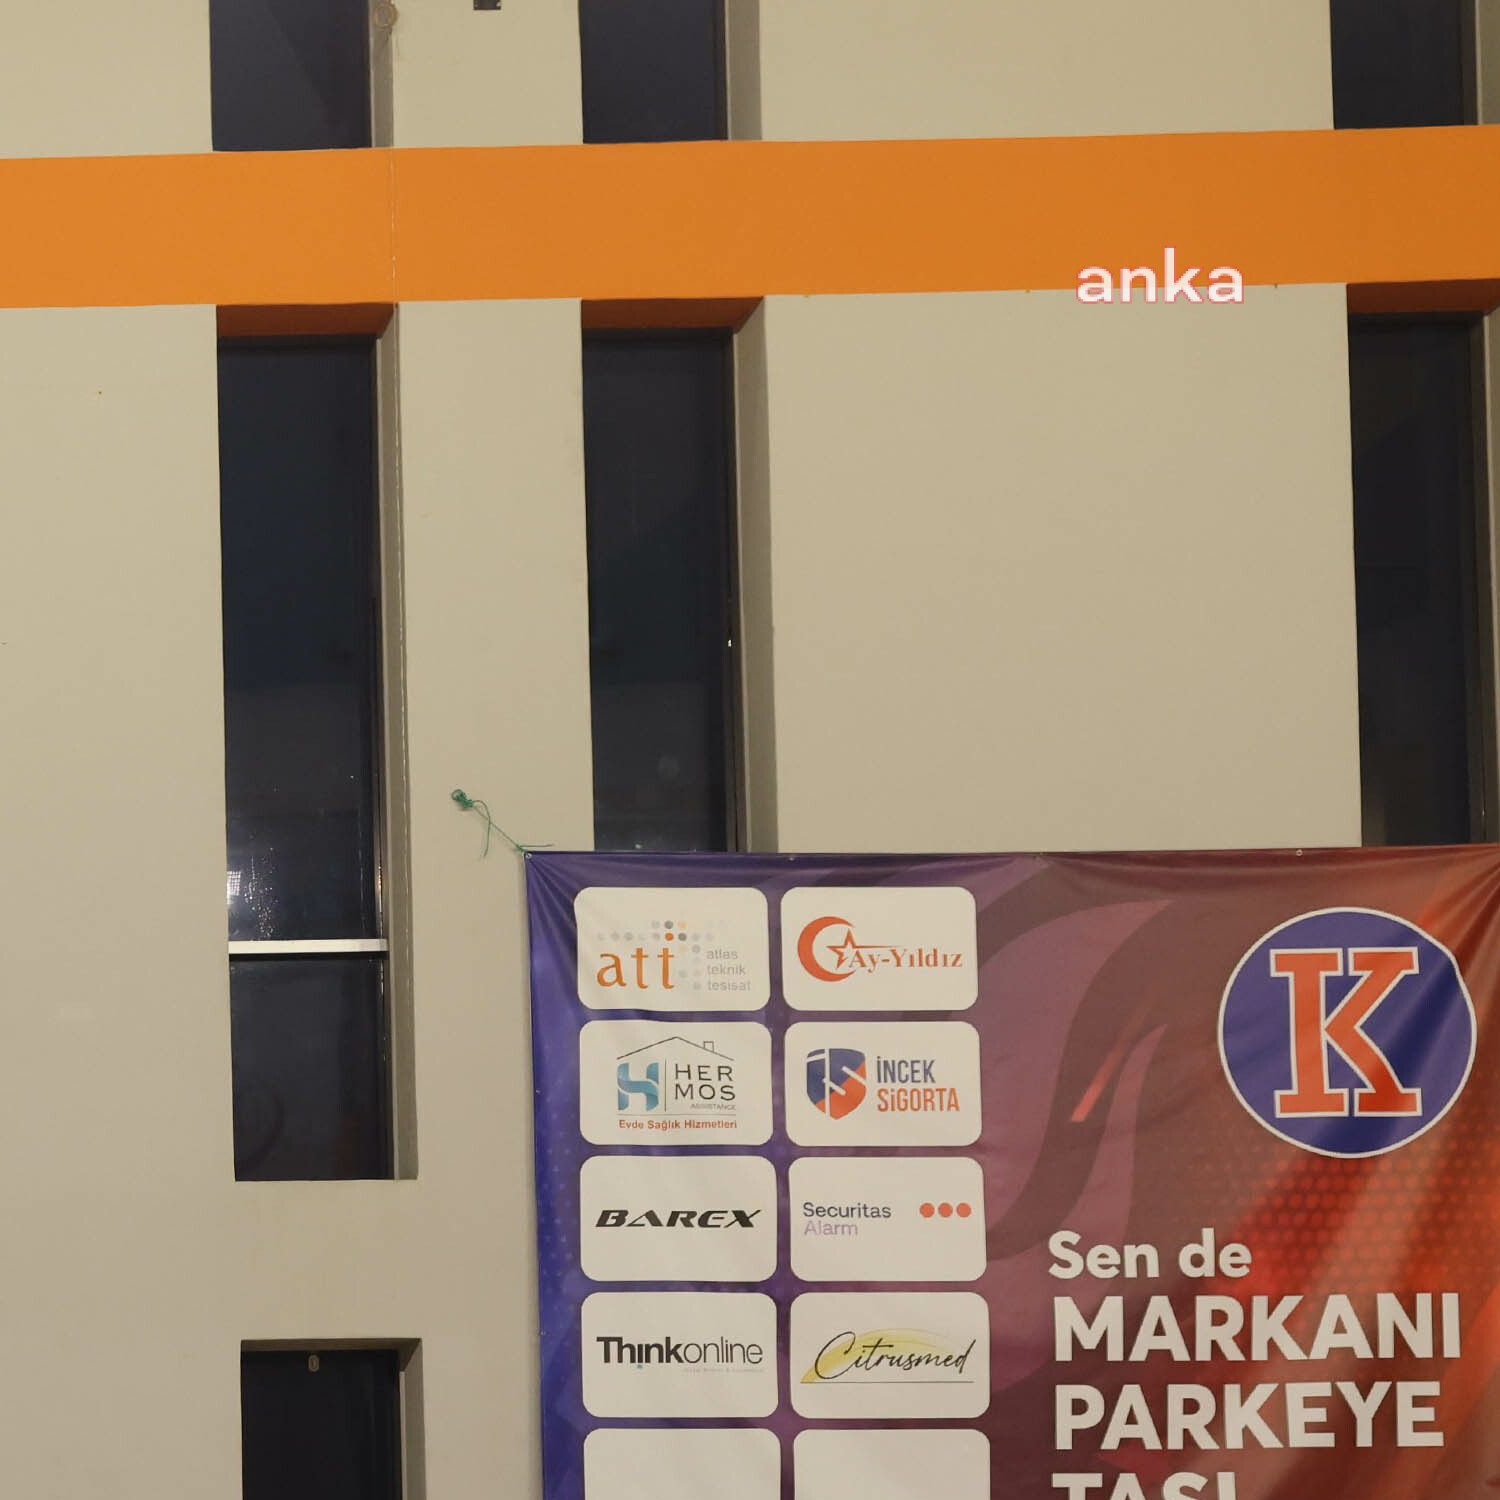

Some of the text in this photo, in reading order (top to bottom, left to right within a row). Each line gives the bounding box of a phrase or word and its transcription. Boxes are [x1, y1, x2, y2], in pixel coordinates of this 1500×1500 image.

[706, 949, 738, 960] atlas
[597, 947, 675, 989] att
[706, 964, 747, 976] teknik
[707, 980, 752, 991] tesisat
[1270, 947, 1422, 1117] K
[674, 1063, 733, 1081] HER
[876, 1056, 935, 1084] İNCEK
[674, 1083, 736, 1101] MOS
[618, 1119, 738, 1132] Evde Sağlık Hizmetleri
[595, 1209, 762, 1228] BAREX
[802, 1201, 892, 1219] Securitas
[804, 1221, 858, 1236] Alarm
[1047, 1228, 1252, 1279] Sen de
[1054, 1293, 1461, 1362] MARKANI
[814, 1331, 976, 1380] Citrusmed
[1054, 1381, 1444, 1450] PARKEYE
